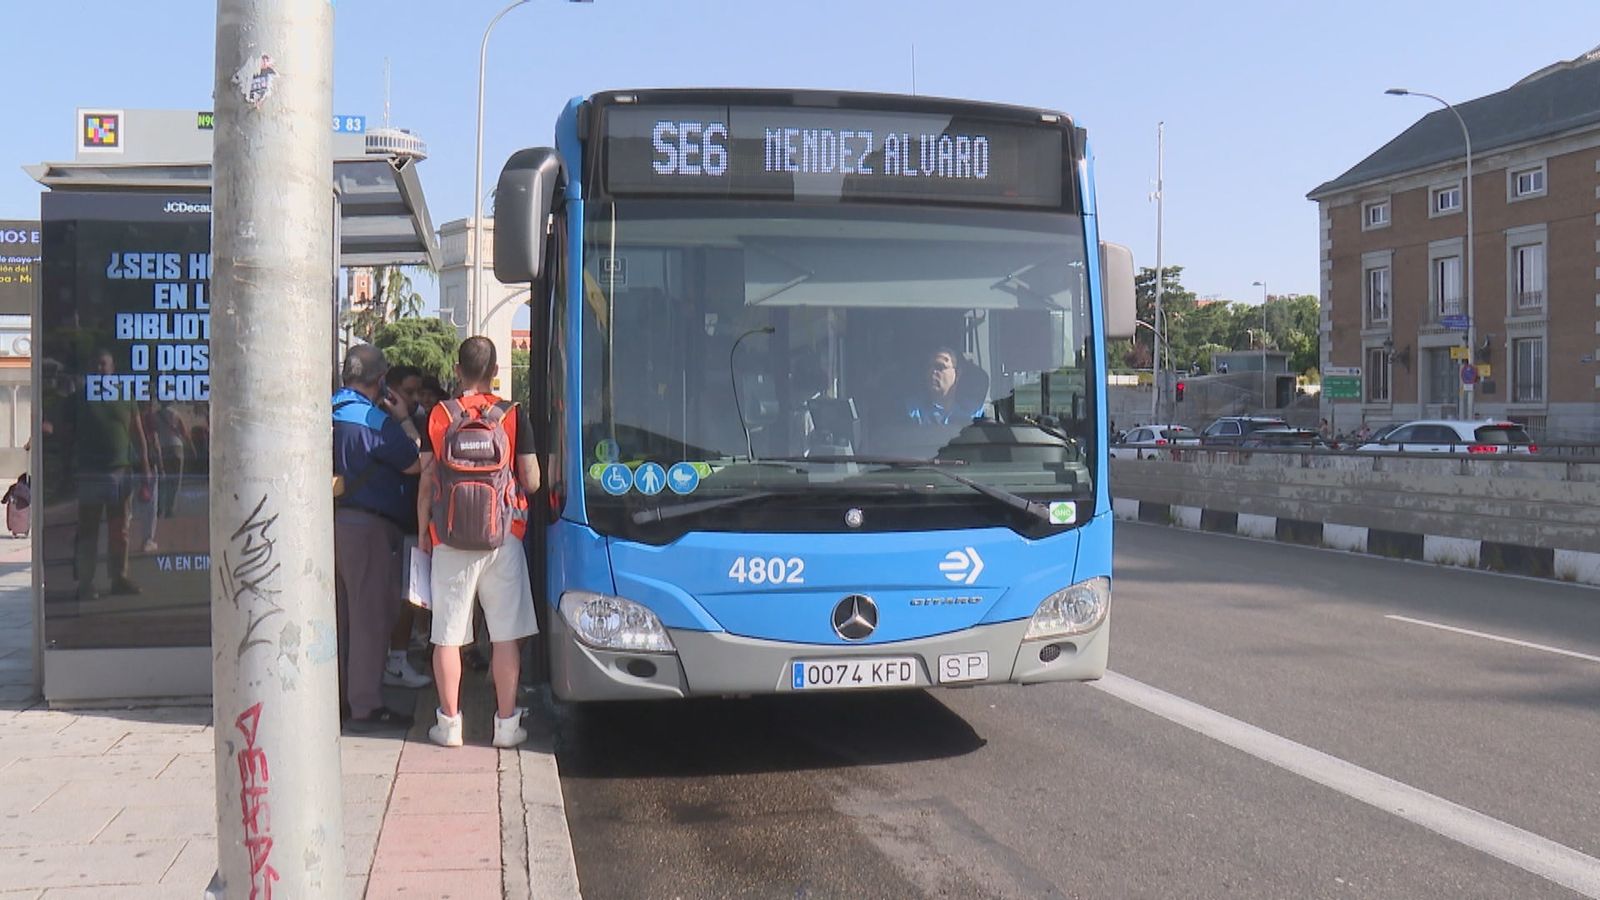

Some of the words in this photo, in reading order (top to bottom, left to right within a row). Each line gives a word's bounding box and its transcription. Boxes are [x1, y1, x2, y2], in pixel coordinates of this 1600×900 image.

[346, 118, 361, 131] 83
[652, 121, 727, 176] SE6
[765, 128, 873, 175] MENDEZ
[885, 133, 989, 179] ALVARO
[106, 252, 181, 279] ¿SEIS
[154, 283, 188, 309] EN
[132, 344, 149, 371] O
[157, 344, 209, 371] DOS
[86, 375, 150, 401] ESTE
[158, 375, 210, 401] COC
[157, 556, 172, 570] YA
[176, 556, 191, 570] EN
[728, 556, 805, 584] 4802
[808, 664, 863, 685] 0074
[872, 662, 911, 684] KFD
